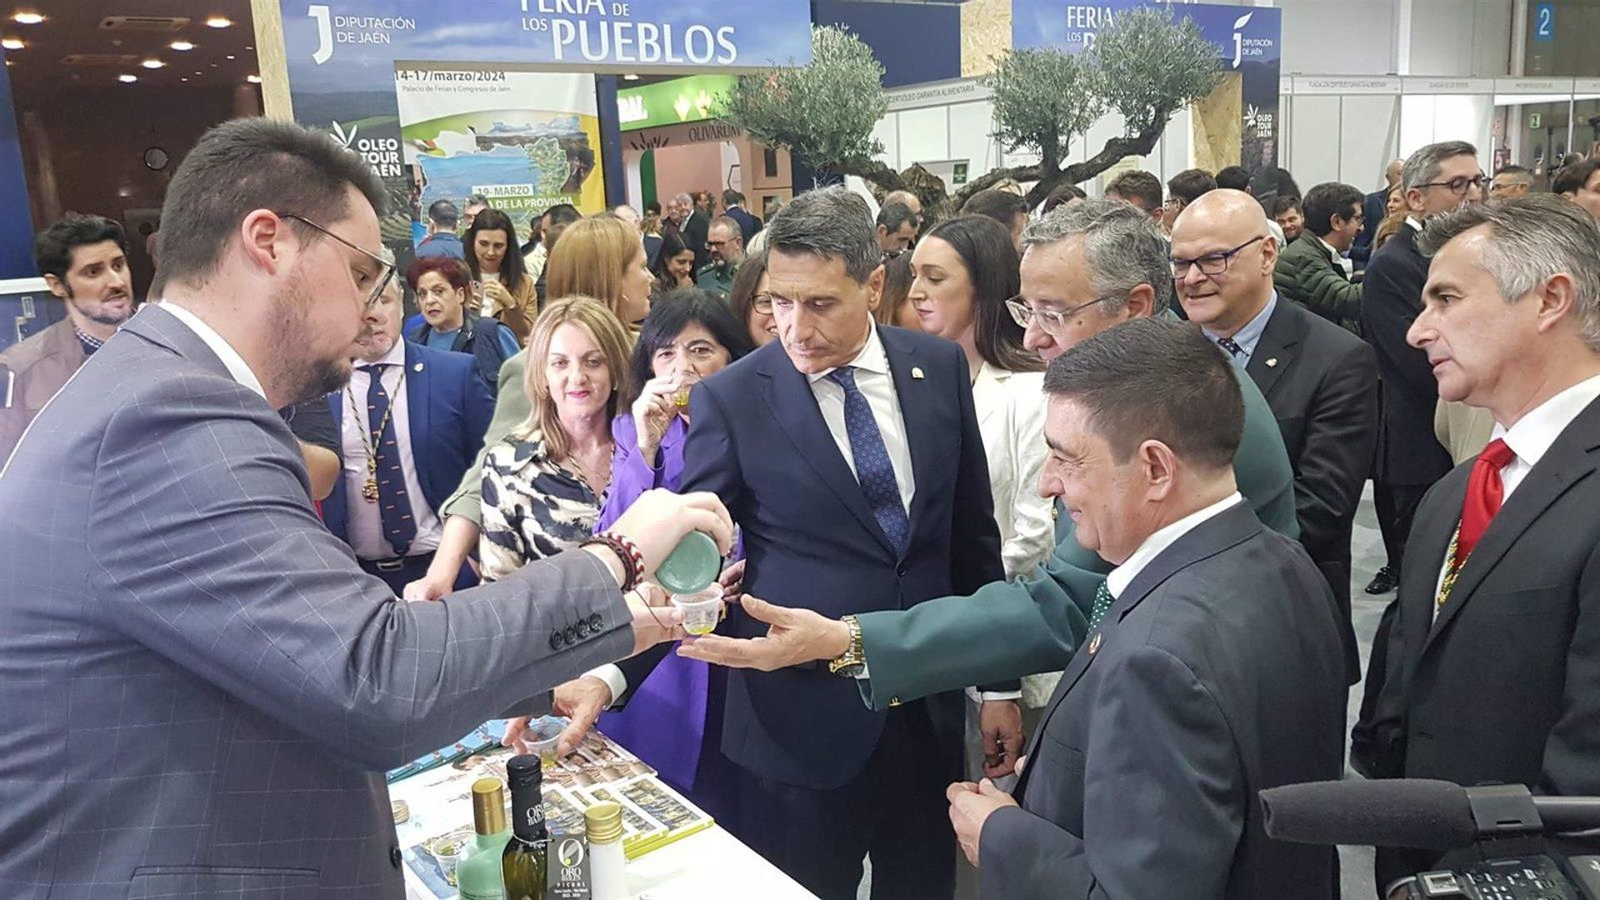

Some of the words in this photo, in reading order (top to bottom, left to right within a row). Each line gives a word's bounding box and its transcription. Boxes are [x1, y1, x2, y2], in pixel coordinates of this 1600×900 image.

[612, 3, 629, 16] DE
[335, 16, 416, 29] DIPUTACIÓN
[1540, 8, 1550, 35] 2
[336, 32, 355, 43] DE
[357, 32, 391, 44] JAÉN
[522, 18, 547, 31] LOS
[552, 19, 737, 64] PUEBLOS
[1067, 32, 1081, 42] LOS
[1256, 114, 1273, 122] OLEO
[1257, 122, 1272, 130] TOUR
[688, 125, 741, 142] OLIVARUM
[358, 138, 399, 152] OLEO
[360, 151, 400, 165] TOUR
[495, 185, 530, 196] MARZO
[495, 200, 509, 210] DE
[510, 198, 524, 209] LA
[524, 196, 574, 208] PROVINCIA
[561, 867, 582, 877] ORO
